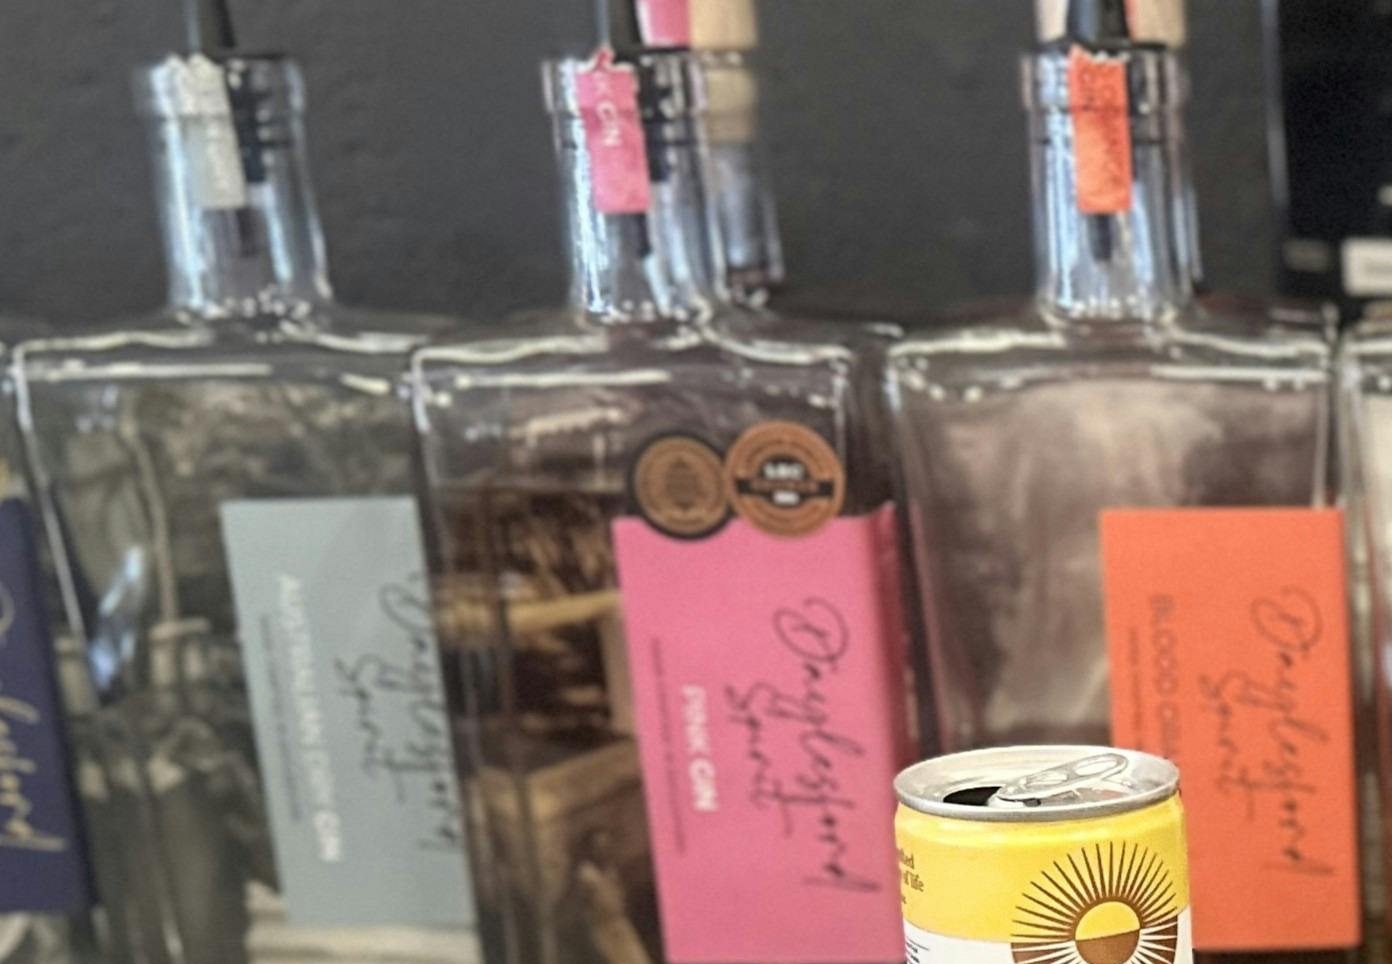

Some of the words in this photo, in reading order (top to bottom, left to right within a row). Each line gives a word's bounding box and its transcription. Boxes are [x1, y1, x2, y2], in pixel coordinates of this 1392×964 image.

[1150, 593, 1181, 694] BLOOD
[679, 684, 713, 755] PINK
[690, 758, 719, 812] GIN
[725, 681, 794, 836] Spirit
[765, 600, 880, 894] Daylesford
[1198, 671, 1256, 819] Spirit
[1238, 588, 1336, 876] Daylesford
